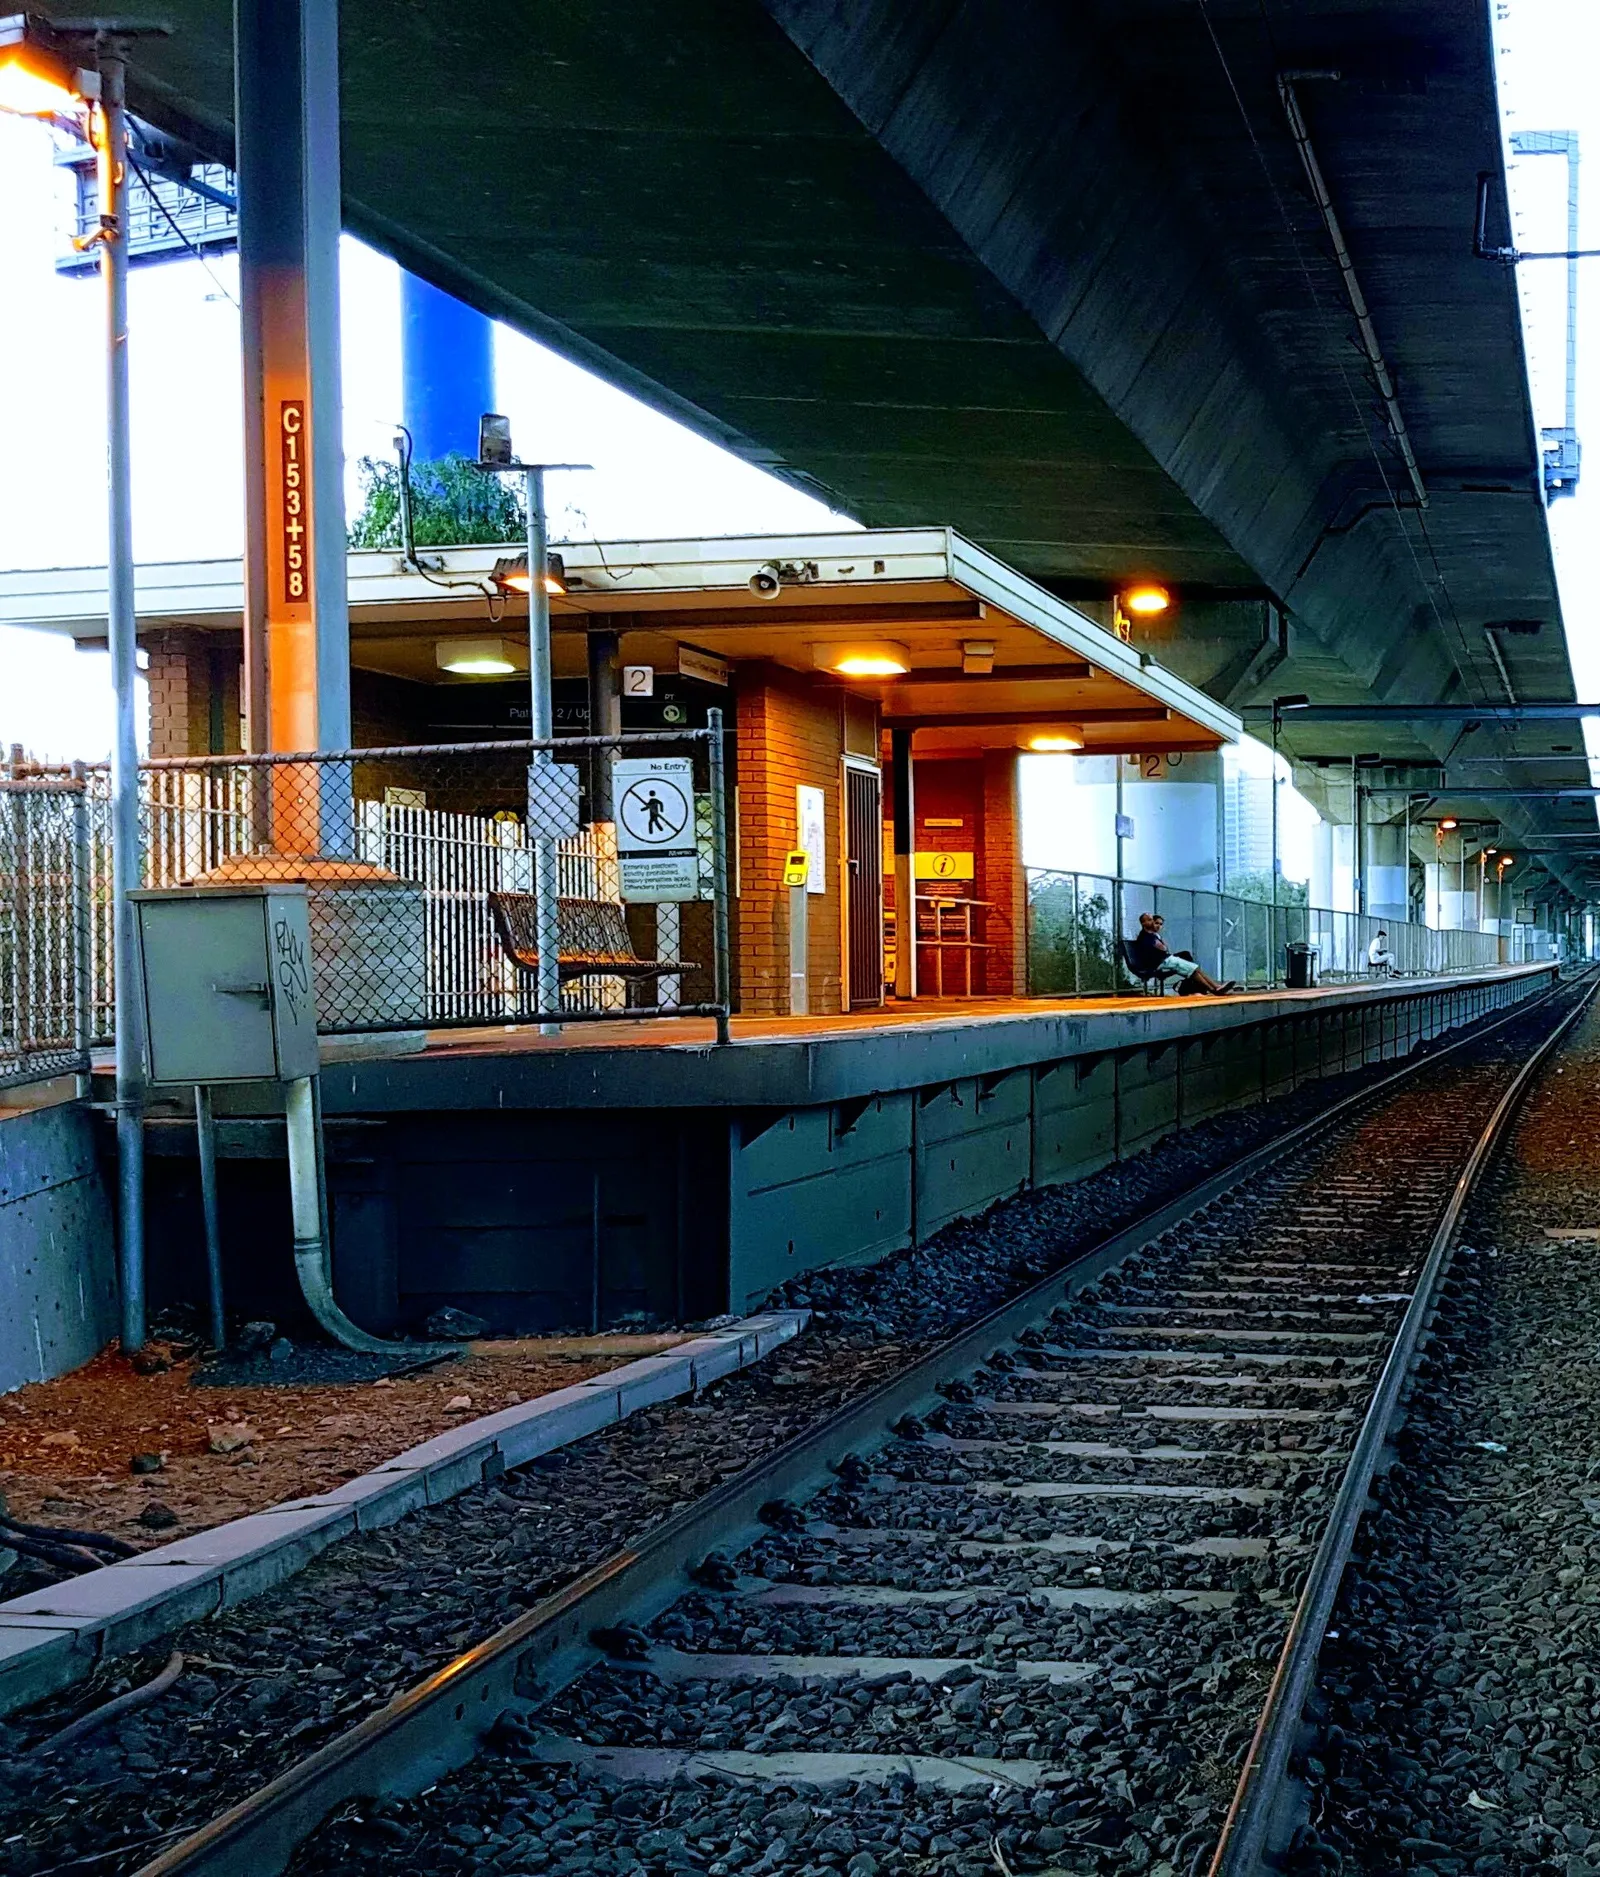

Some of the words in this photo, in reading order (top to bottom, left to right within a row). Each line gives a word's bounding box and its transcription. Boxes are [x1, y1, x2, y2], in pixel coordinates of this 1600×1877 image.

[282, 407, 304, 597] C153+58
[630, 669, 647, 692] 2
[556, 707, 565, 719] 2
[650, 763, 661, 771] No
[664, 763, 687, 772] Entry
[1145, 754, 1162, 777] 2
